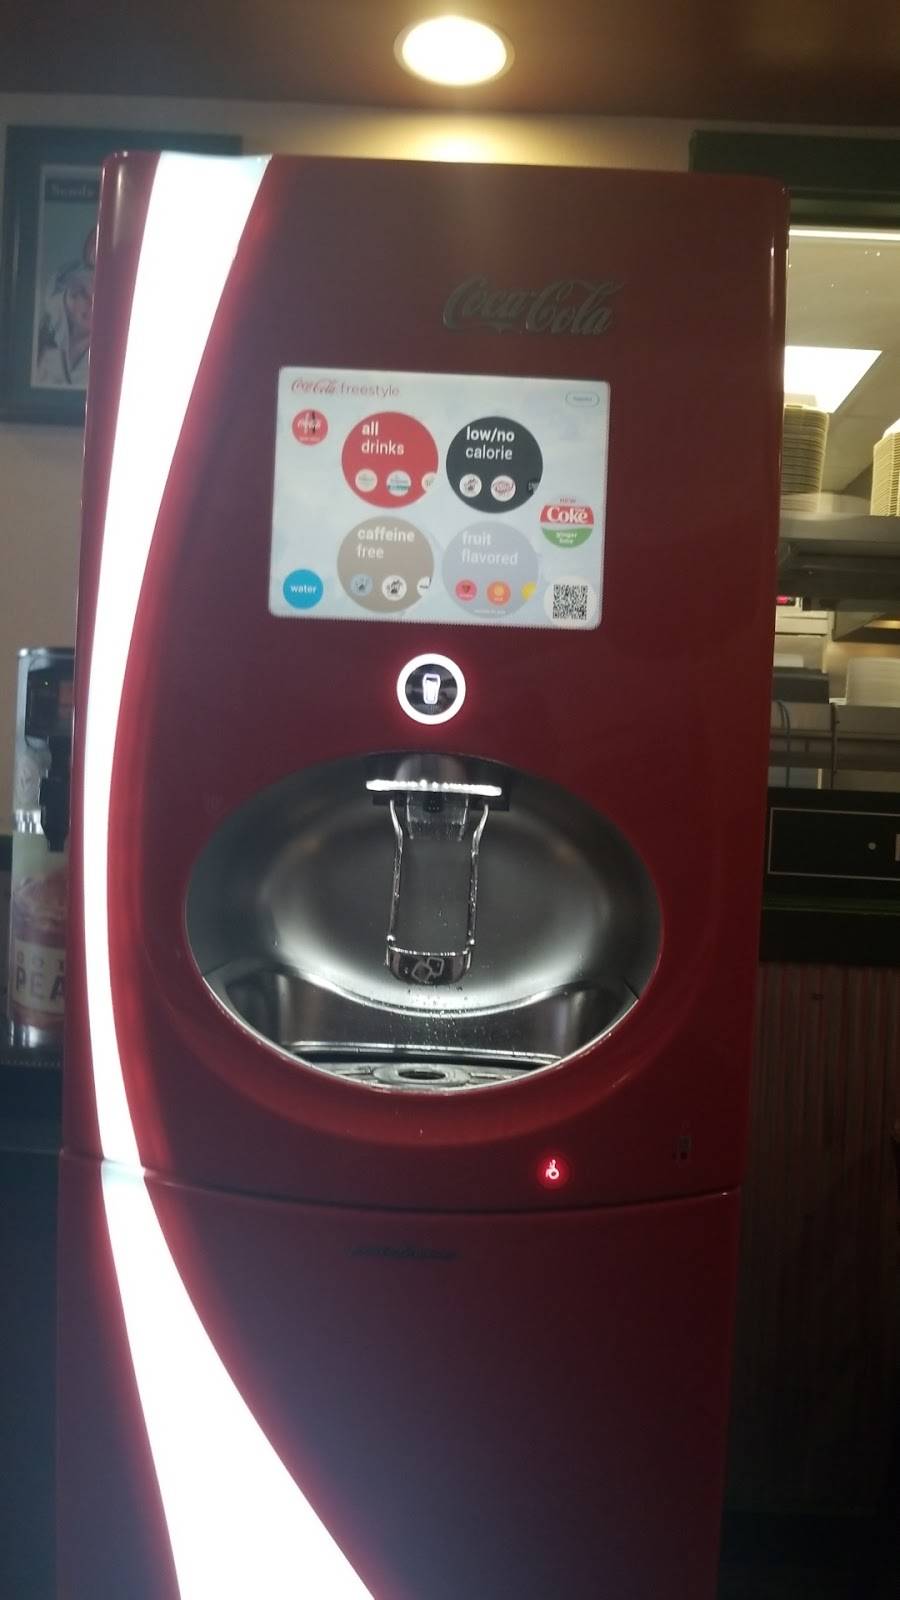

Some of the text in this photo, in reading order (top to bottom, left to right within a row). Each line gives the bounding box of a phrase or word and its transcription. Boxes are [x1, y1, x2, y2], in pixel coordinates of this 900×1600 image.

[340, 382, 400, 398] freestyle
[361, 420, 379, 437] all
[466, 425, 515, 443] low/no
[360, 439, 405, 456] drinks
[465, 444, 513, 461] calorie
[546, 507, 589, 523] Coke
[357, 527, 415, 543] caffeine
[462, 532, 493, 546] fruit
[356, 544, 385, 559] free
[461, 549, 519, 566] flavored
[290, 584, 317, 594] water
